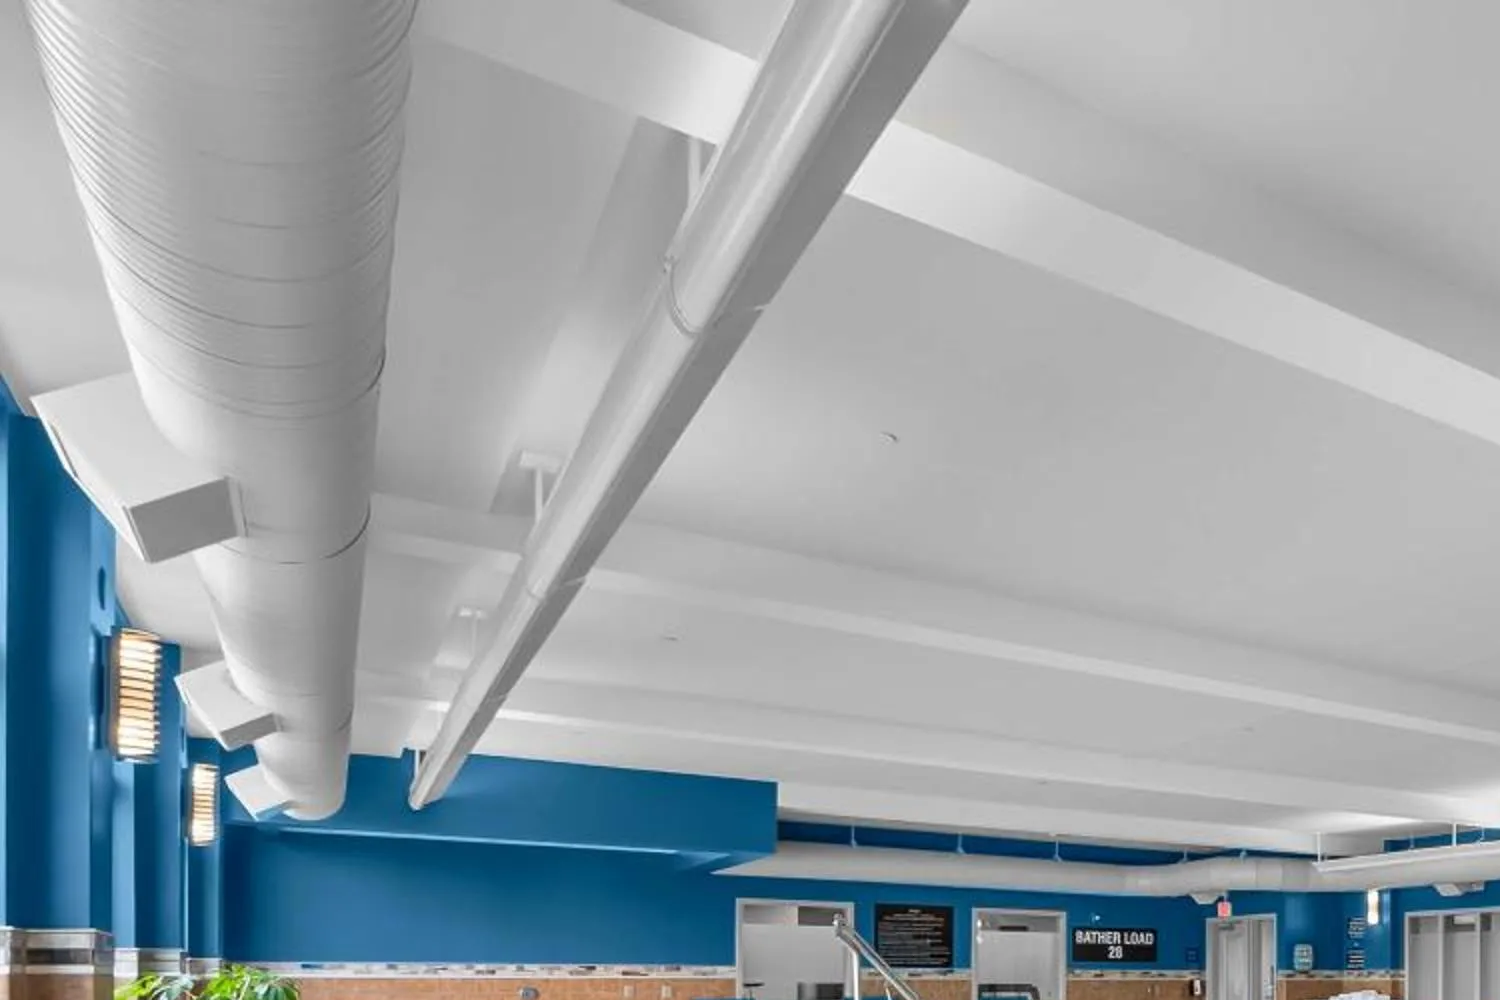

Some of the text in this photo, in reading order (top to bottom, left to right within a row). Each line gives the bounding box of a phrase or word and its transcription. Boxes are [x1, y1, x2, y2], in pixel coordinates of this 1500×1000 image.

[1075, 930, 1154, 945] BATHER LOAD
[1108, 945, 1123, 959] 28
